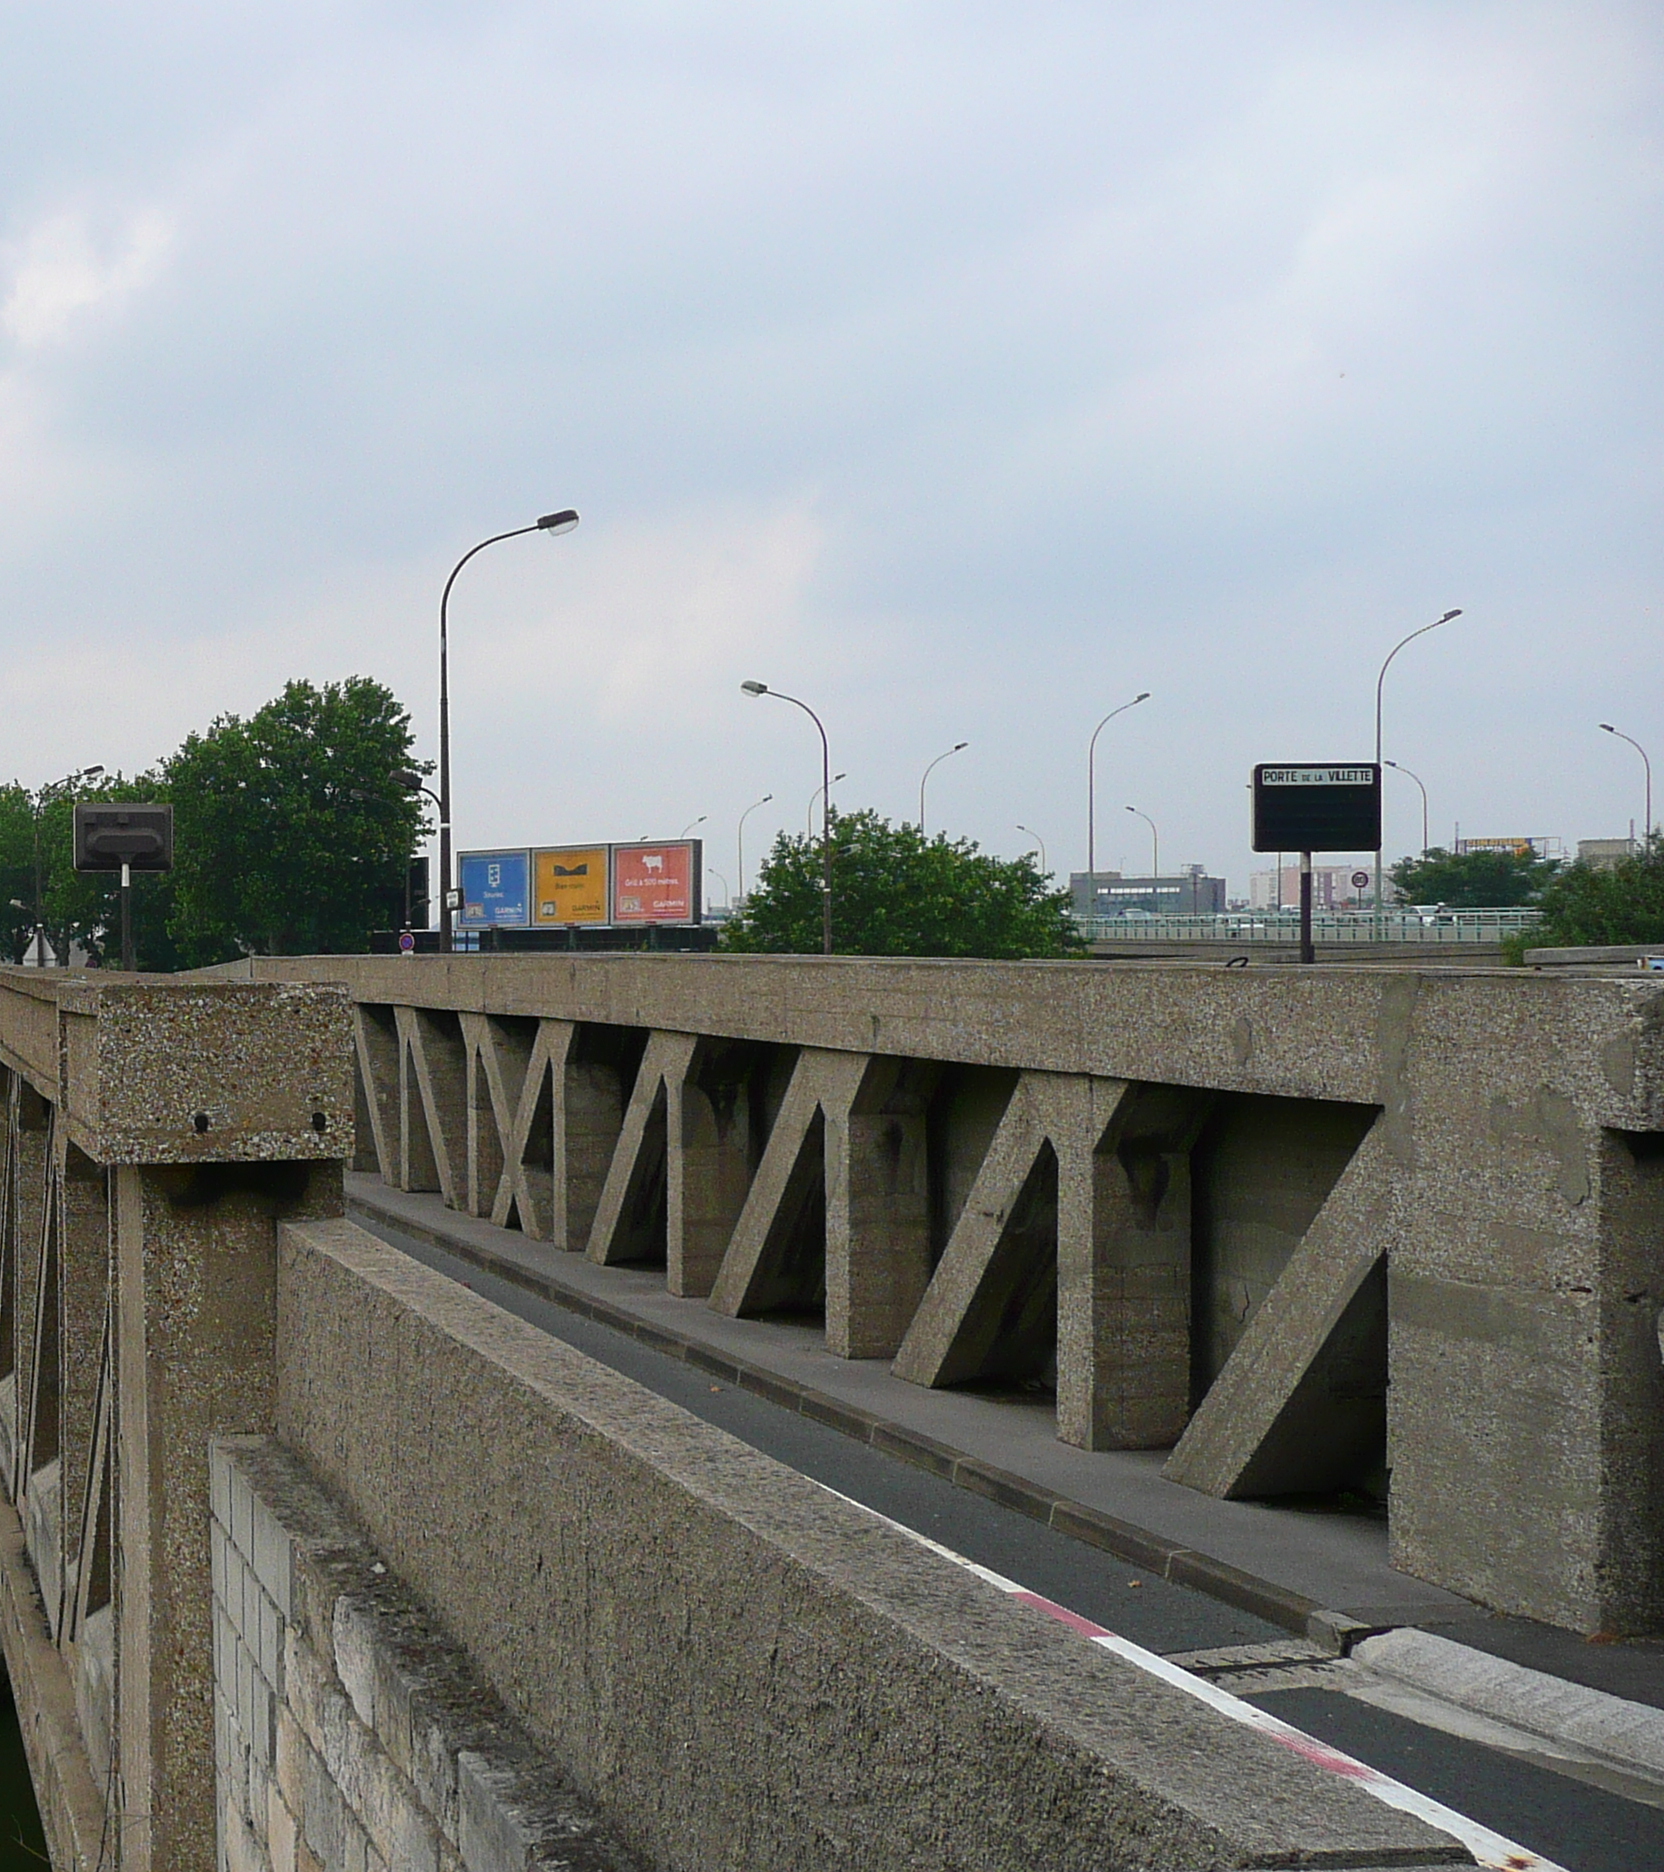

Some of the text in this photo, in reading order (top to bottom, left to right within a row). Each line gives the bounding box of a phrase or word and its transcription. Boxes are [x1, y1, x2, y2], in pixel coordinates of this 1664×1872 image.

[1264, 771, 1297, 782] PORTE
[1328, 770, 1371, 782] VILLETTE
[653, 900, 684, 908] GARMIN
